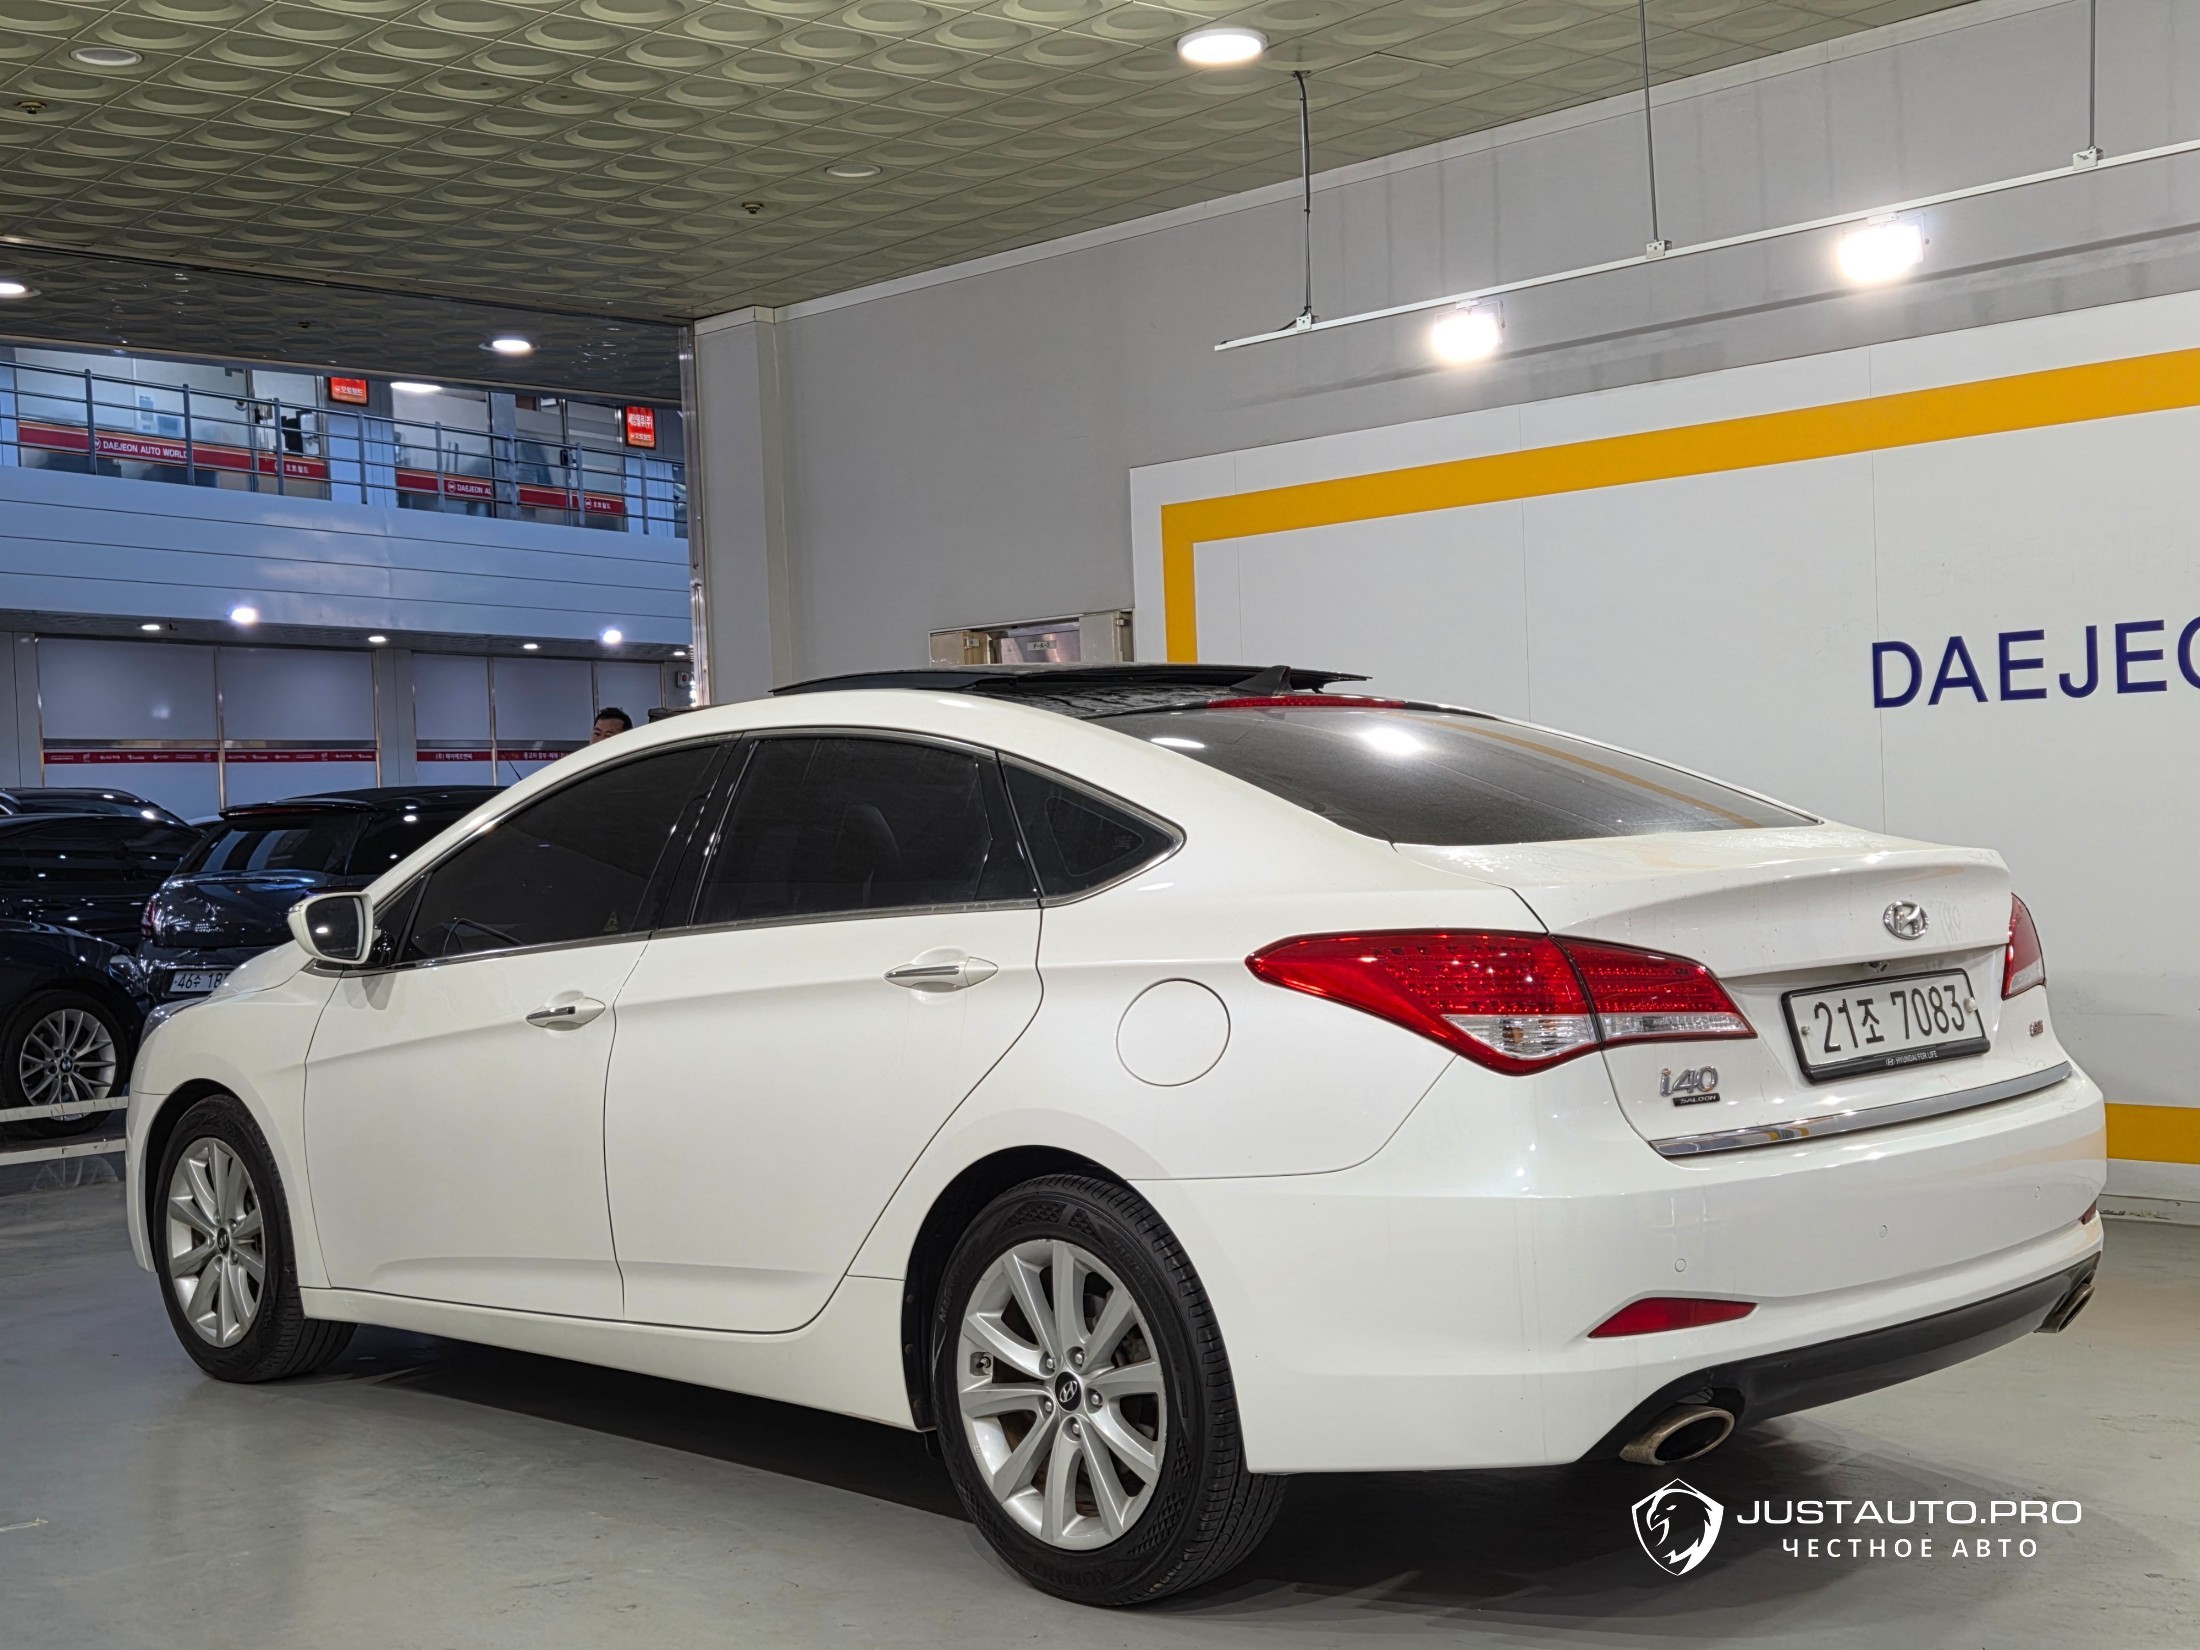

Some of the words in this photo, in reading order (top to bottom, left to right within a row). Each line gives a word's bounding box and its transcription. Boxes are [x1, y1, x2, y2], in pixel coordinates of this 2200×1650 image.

[103, 440, 138, 452] DAEJEON
[140, 445, 161, 455] AUTO
[457, 484, 483, 494] DAEJEON
[177, 972, 201, 989] 46수
[208, 972, 230, 989] 18
[1814, 998, 1886, 1053] 21조
[1890, 984, 1965, 1040] 7083
[1895, 1054, 1917, 1065] HYUNDAI
[1916, 1052, 1927, 1061] FOR
[1926, 1050, 1938, 1059] LIFE
[1660, 1066, 1718, 1097] i40
[1680, 1095, 1716, 1104] SALOON
